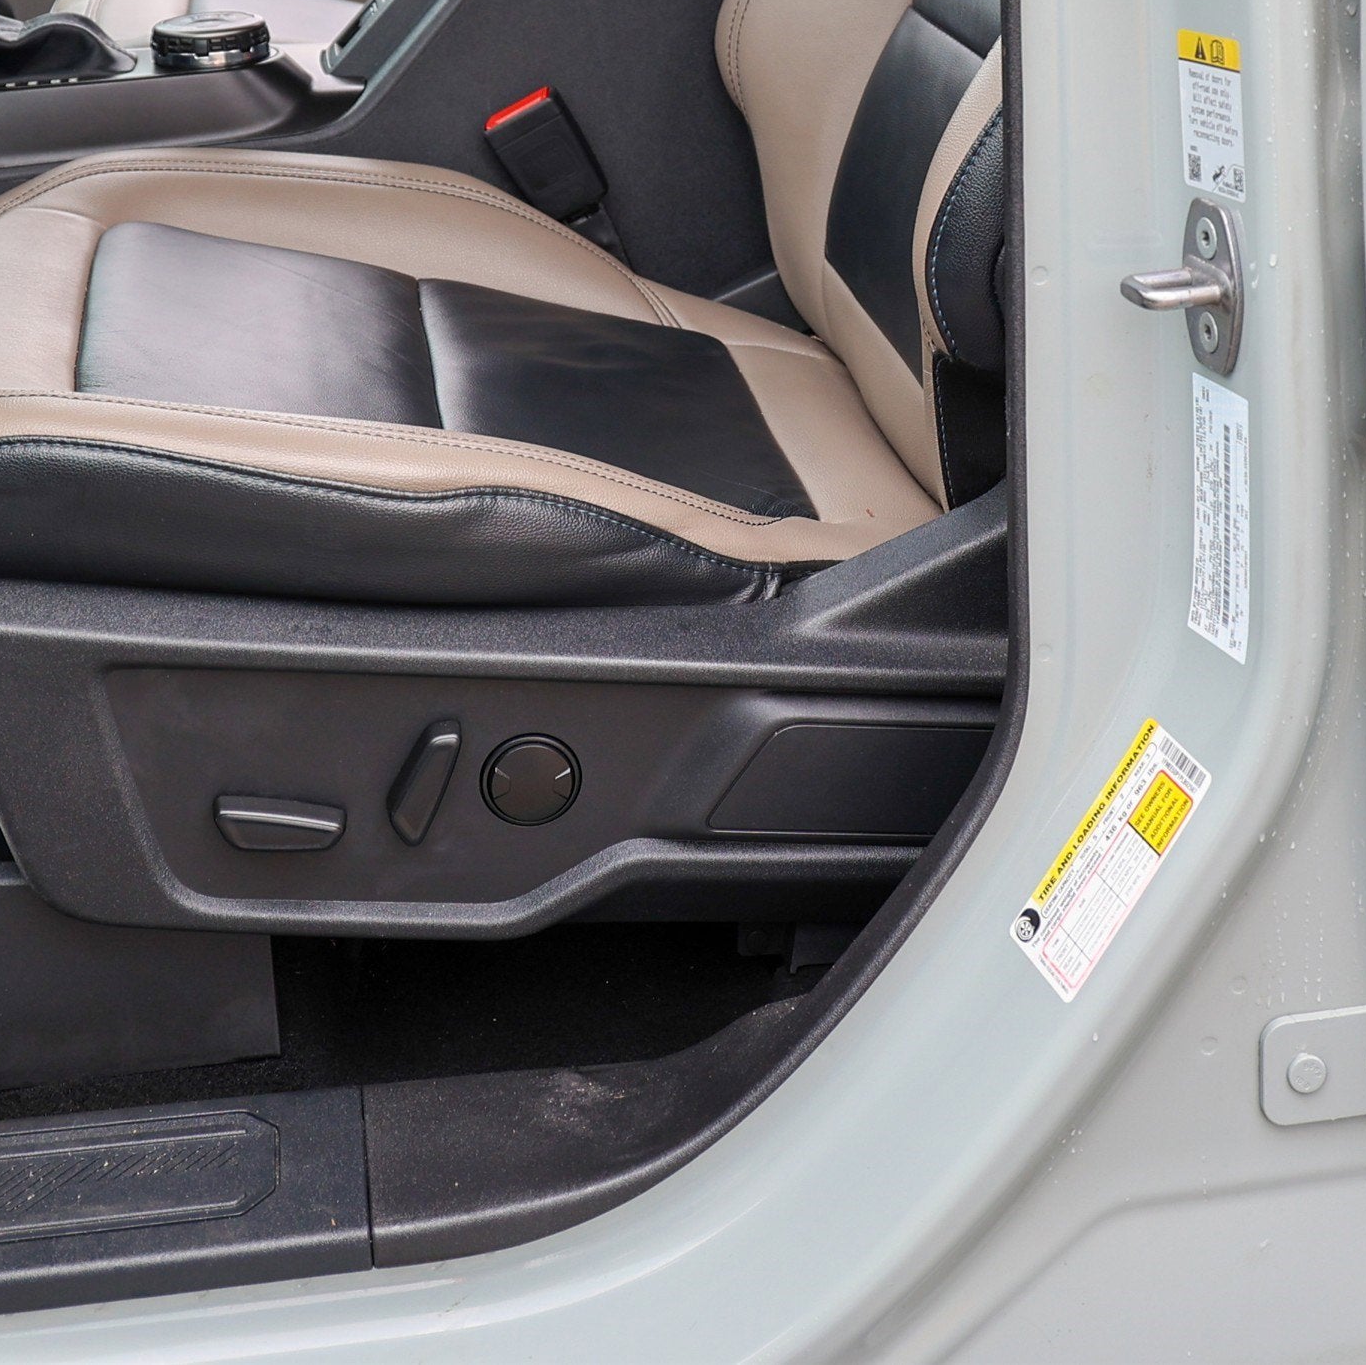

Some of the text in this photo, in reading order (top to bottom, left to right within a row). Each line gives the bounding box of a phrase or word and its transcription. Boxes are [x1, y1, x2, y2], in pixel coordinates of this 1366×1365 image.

[1038, 875, 1058, 901] TIRE
[1056, 852, 1074, 876] AND
[1073, 801, 1106, 851] LOADING
[1105, 724, 1155, 801] INFORMATION
[1105, 825, 1118, 841] 436
[1118, 811, 1128, 822] kg
[1126, 800, 1133, 810] or
[1134, 779, 1147, 795] 963
[1135, 781, 1166, 827] SEE OWNERS
[1141, 787, 1173, 834] MANUAL FOR
[1150, 798, 1179, 840] ADDITIONAL
[1156, 799, 1189, 849] INFORMATION
